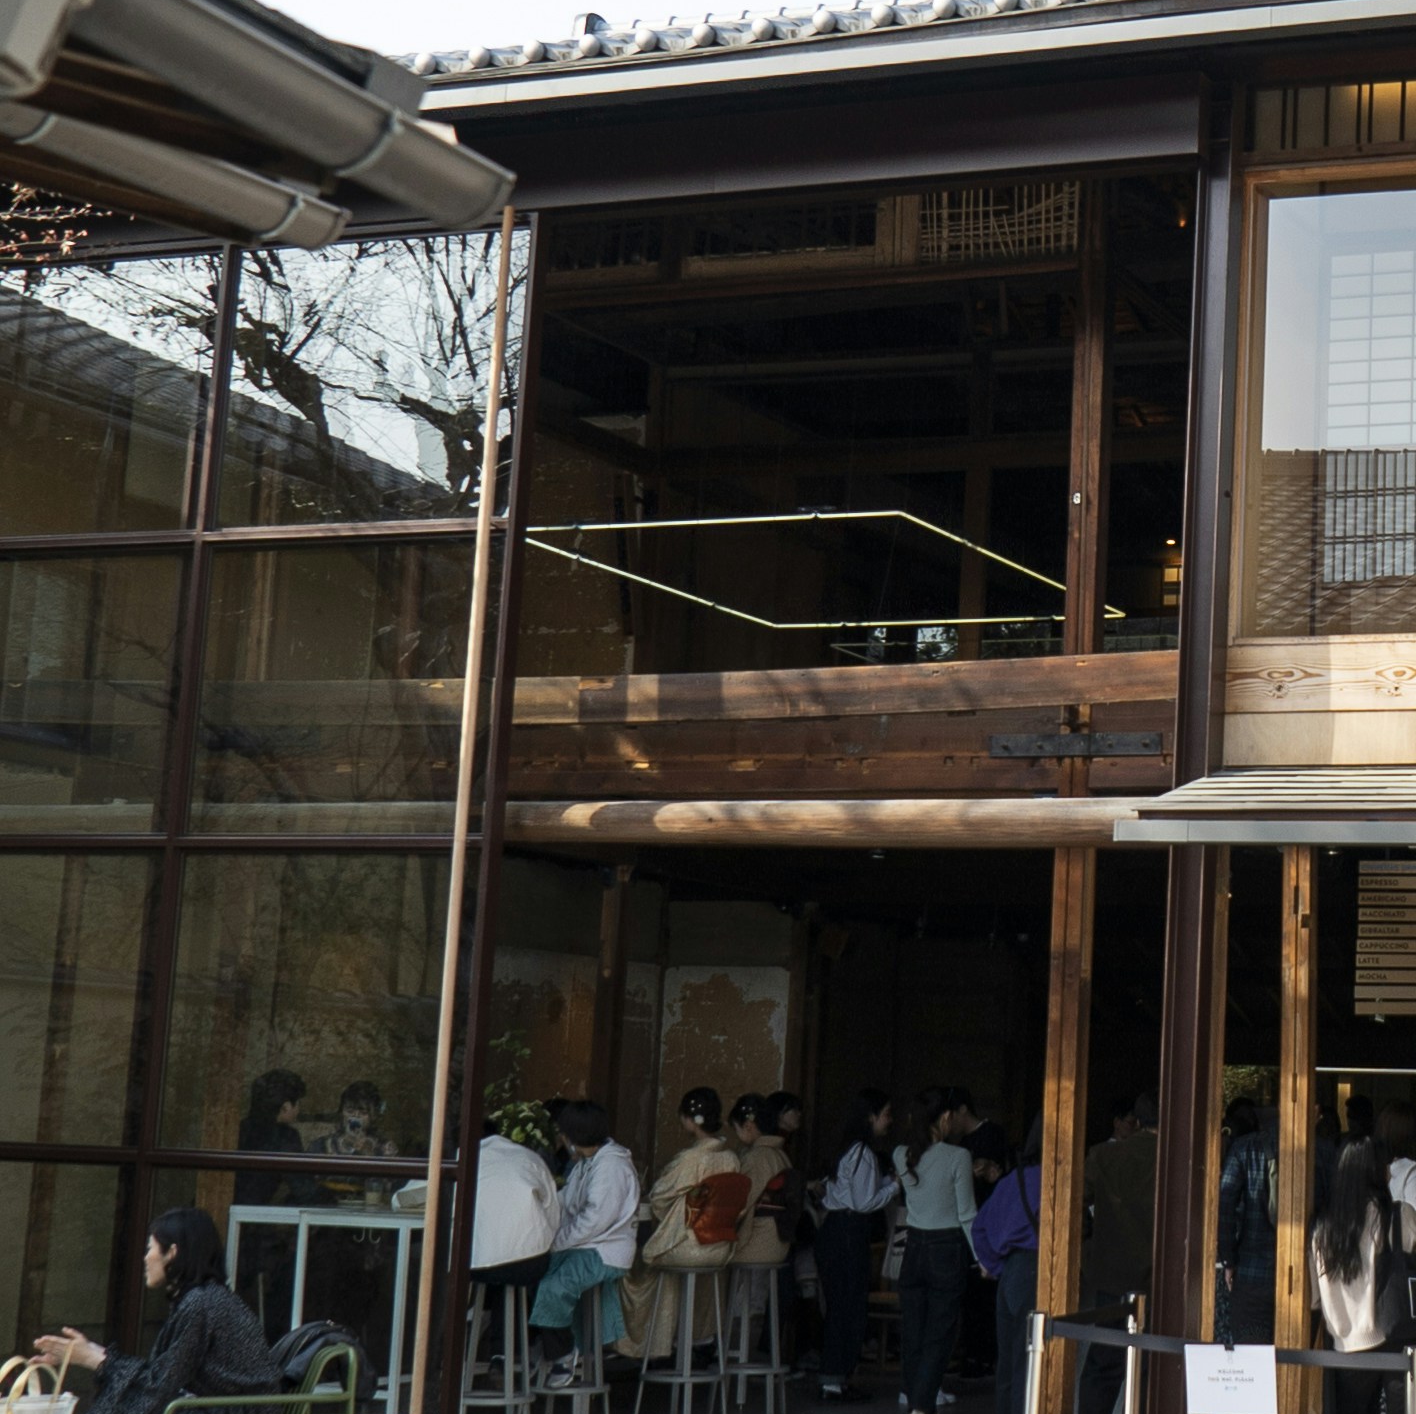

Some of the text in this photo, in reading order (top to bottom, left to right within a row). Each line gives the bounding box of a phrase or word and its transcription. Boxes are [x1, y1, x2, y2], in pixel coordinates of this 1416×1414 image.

[1360, 878, 1399, 886] ESPRESSO
[1360, 895, 1407, 903] AMERICANO
[1360, 910, 1406, 918] MACCHIATO
[1358, 942, 1409, 950] CAPPUCCINO
